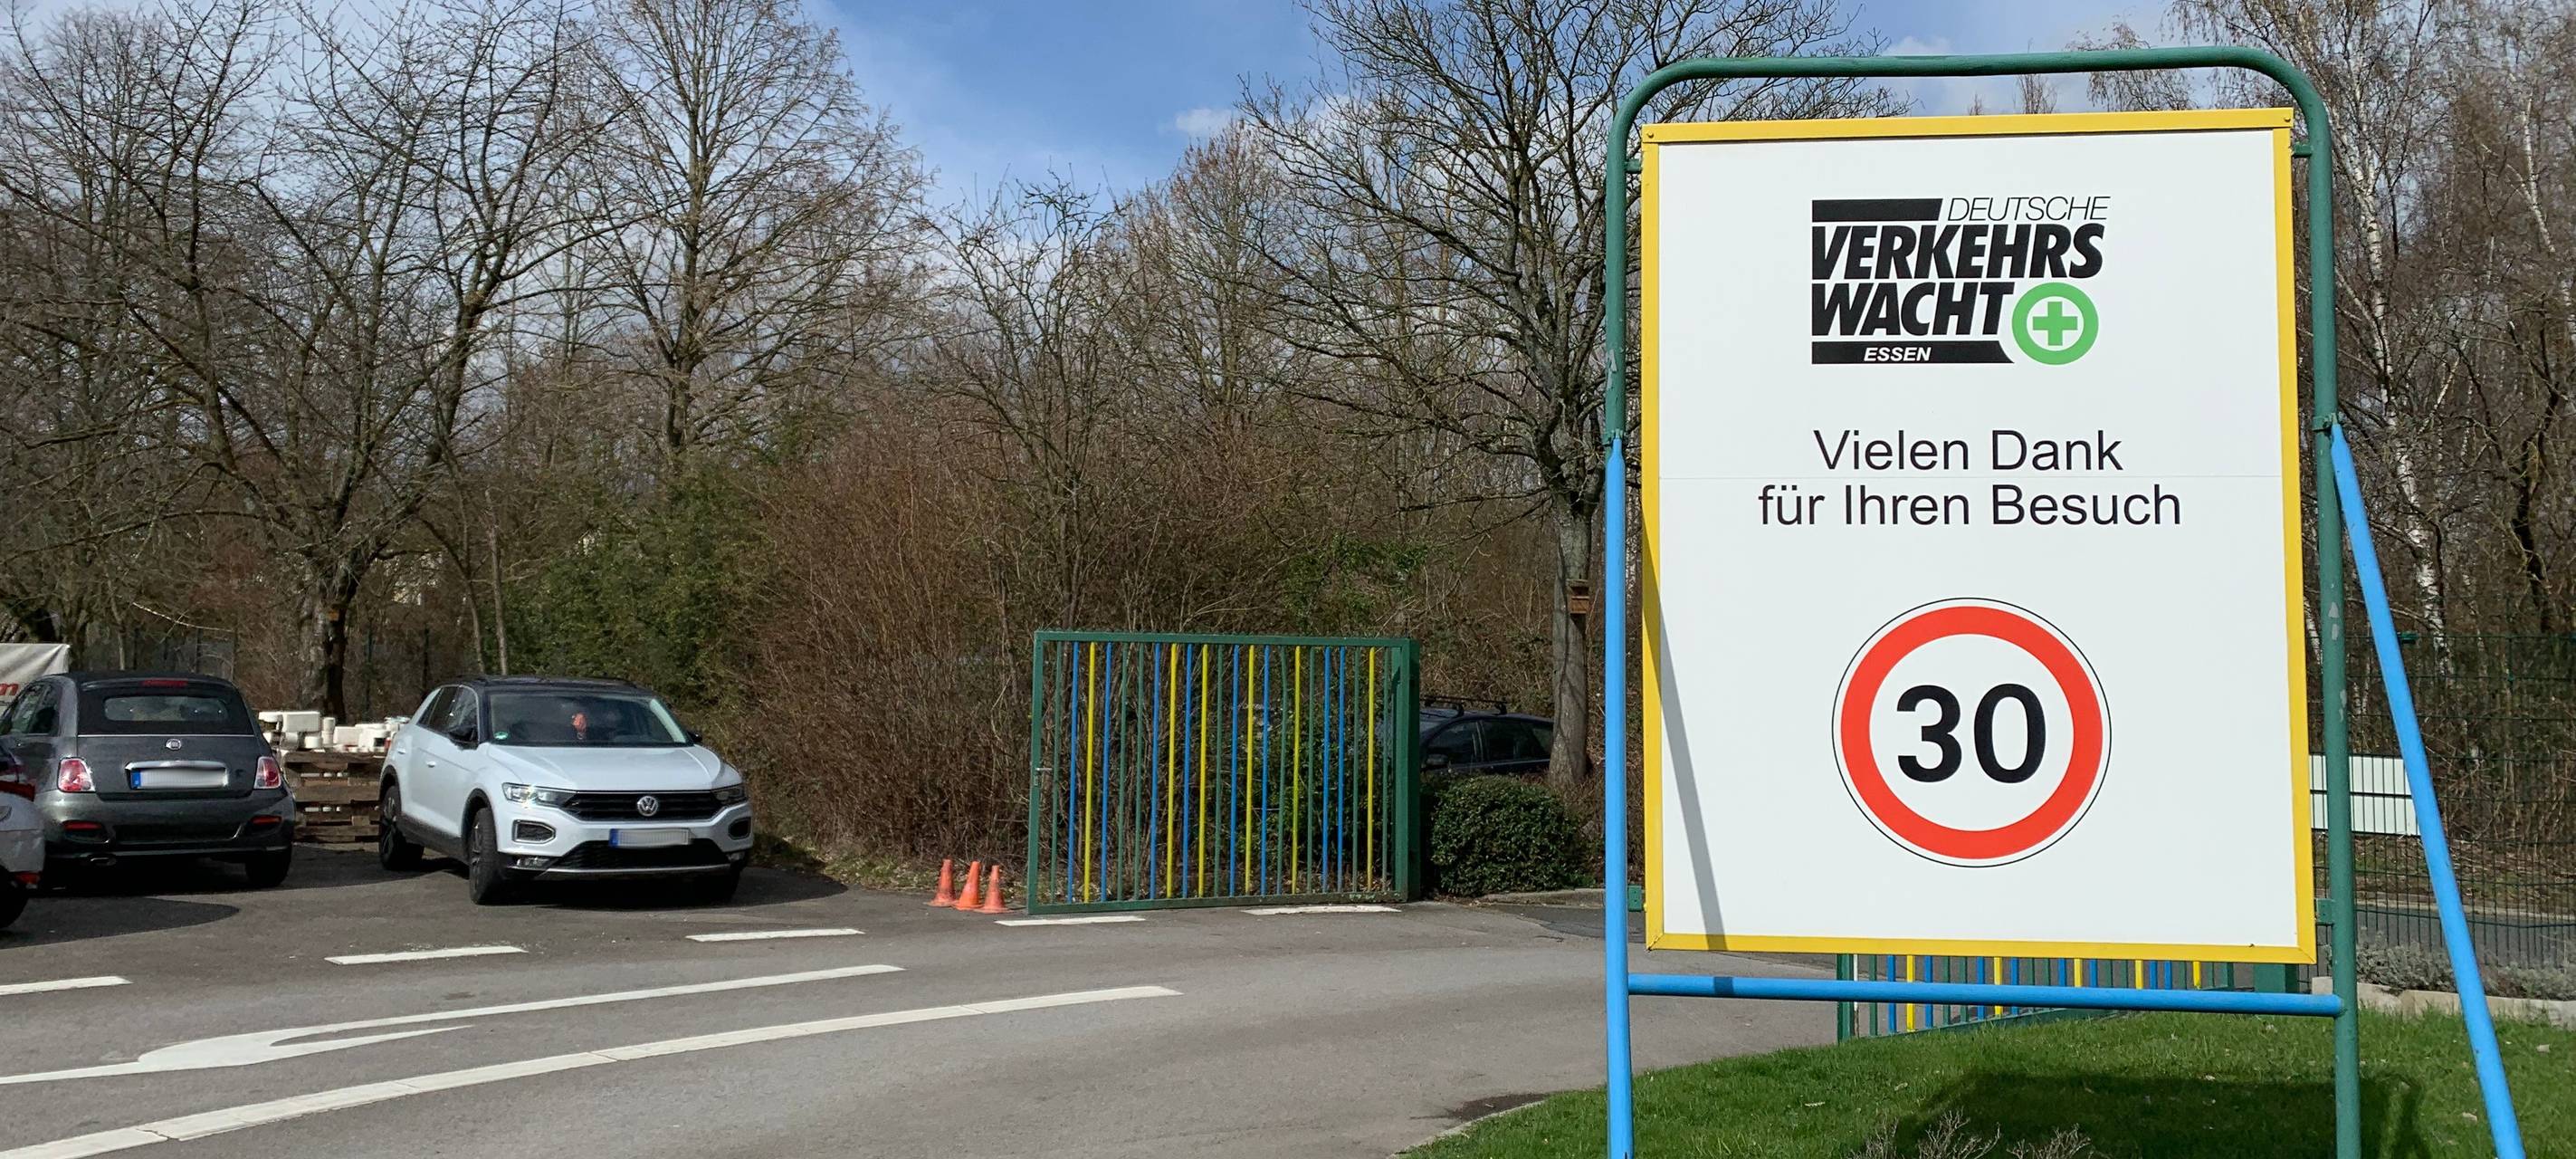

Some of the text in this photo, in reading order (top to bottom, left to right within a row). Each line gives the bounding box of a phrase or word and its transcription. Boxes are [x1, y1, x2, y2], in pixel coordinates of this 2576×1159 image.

[1947, 196, 2111, 222] DEUTSCHE
[1812, 223, 2105, 281] VERKEHRS
[1812, 282, 2016, 337] WACHT
[1864, 346, 1932, 363] ESSEN
[1813, 429, 2123, 471] Vielen Dank
[1758, 483, 2181, 525] für Ihren Besuch
[1896, 683, 2046, 783] 30
